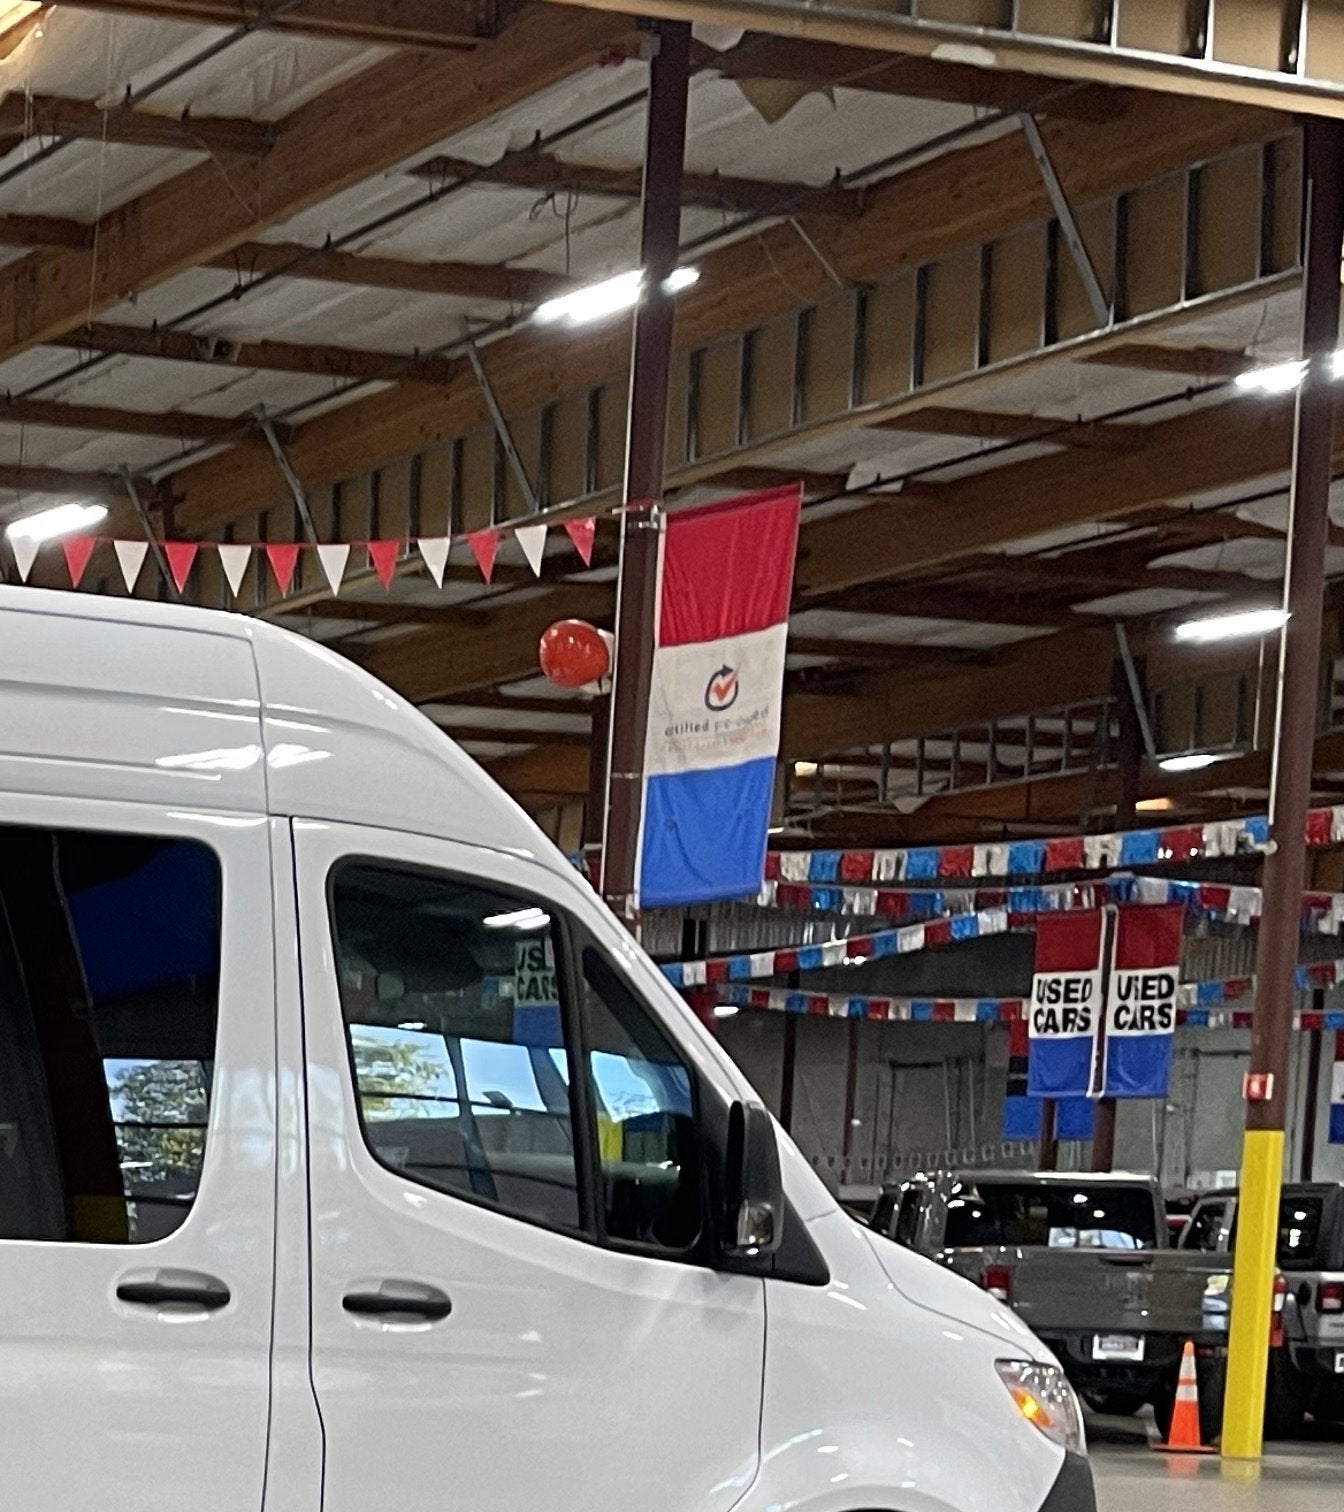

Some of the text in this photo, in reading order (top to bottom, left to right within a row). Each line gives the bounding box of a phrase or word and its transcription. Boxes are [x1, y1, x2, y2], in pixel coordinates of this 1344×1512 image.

[1037, 977, 1093, 1004] USED
[1033, 1006, 1091, 1033] CARS
[1113, 1003, 1173, 1030] CARS
